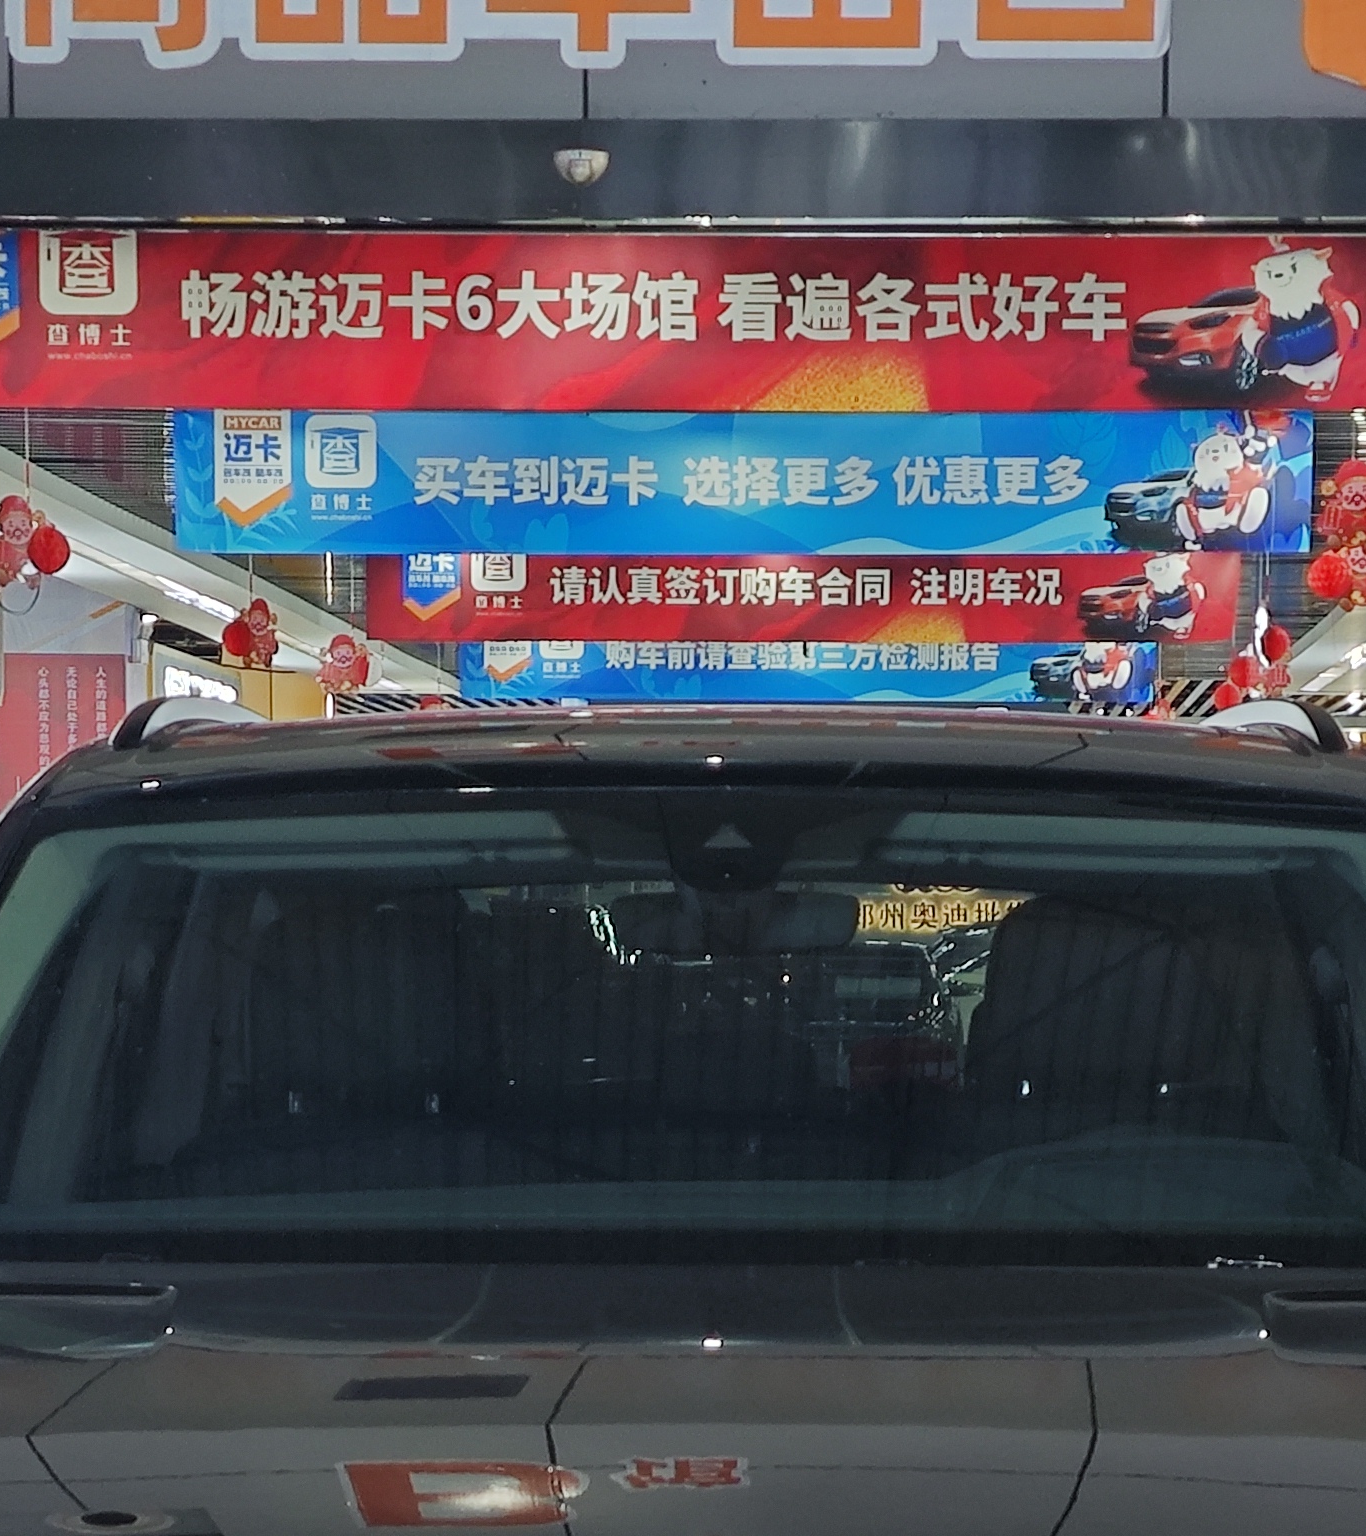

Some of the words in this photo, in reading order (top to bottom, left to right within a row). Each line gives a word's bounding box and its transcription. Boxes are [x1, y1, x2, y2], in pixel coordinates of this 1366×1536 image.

[180, 271, 698, 341] 畅游迈卡6大场馆
[717, 271, 1129, 342] 看遍各式好车
[47, 323, 132, 346] 查博士
[225, 416, 280, 429] MYCAR
[223, 433, 282, 463] 迈卡
[413, 456, 659, 507] 买车到迈卡
[682, 456, 880, 506] 选择更多
[892, 456, 1091, 506] 优惠更多
[310, 494, 373, 511] 查博士
[549, 566, 890, 606] 请认真签订购车合同
[910, 567, 1063, 606] 注明车况
[605, 642, 1000, 671] 购车前请查验第三方检测报告
